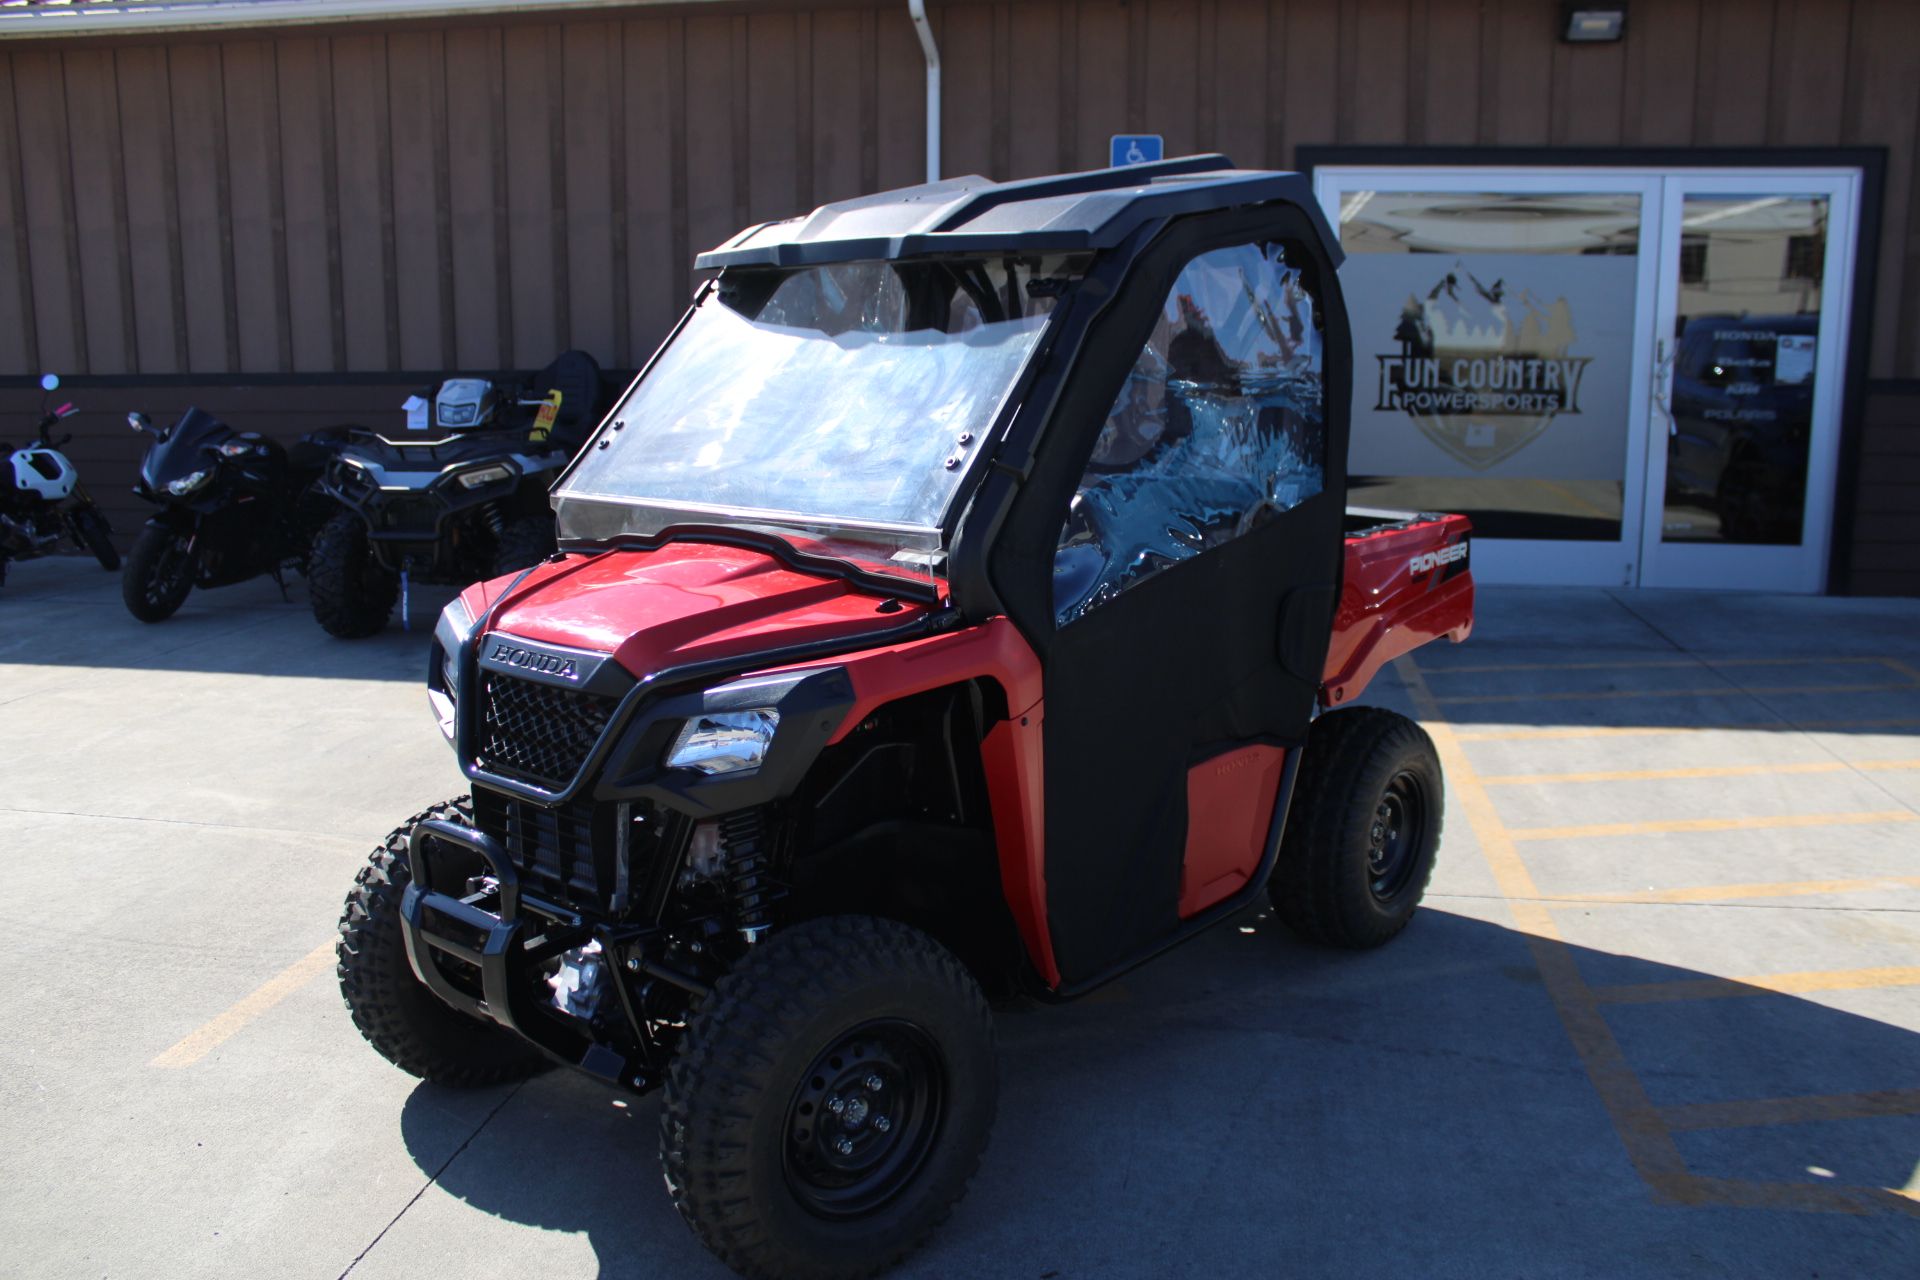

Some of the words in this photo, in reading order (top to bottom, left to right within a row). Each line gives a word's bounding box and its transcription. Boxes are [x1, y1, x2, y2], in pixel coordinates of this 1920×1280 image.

[1379, 356, 1441, 409] FUN
[1453, 355, 1586, 412] COUNTRY
[1403, 391, 1560, 411] POWERSPORTS
[1410, 541, 1468, 576] PIONEER
[490, 644, 578, 680] HONDA
